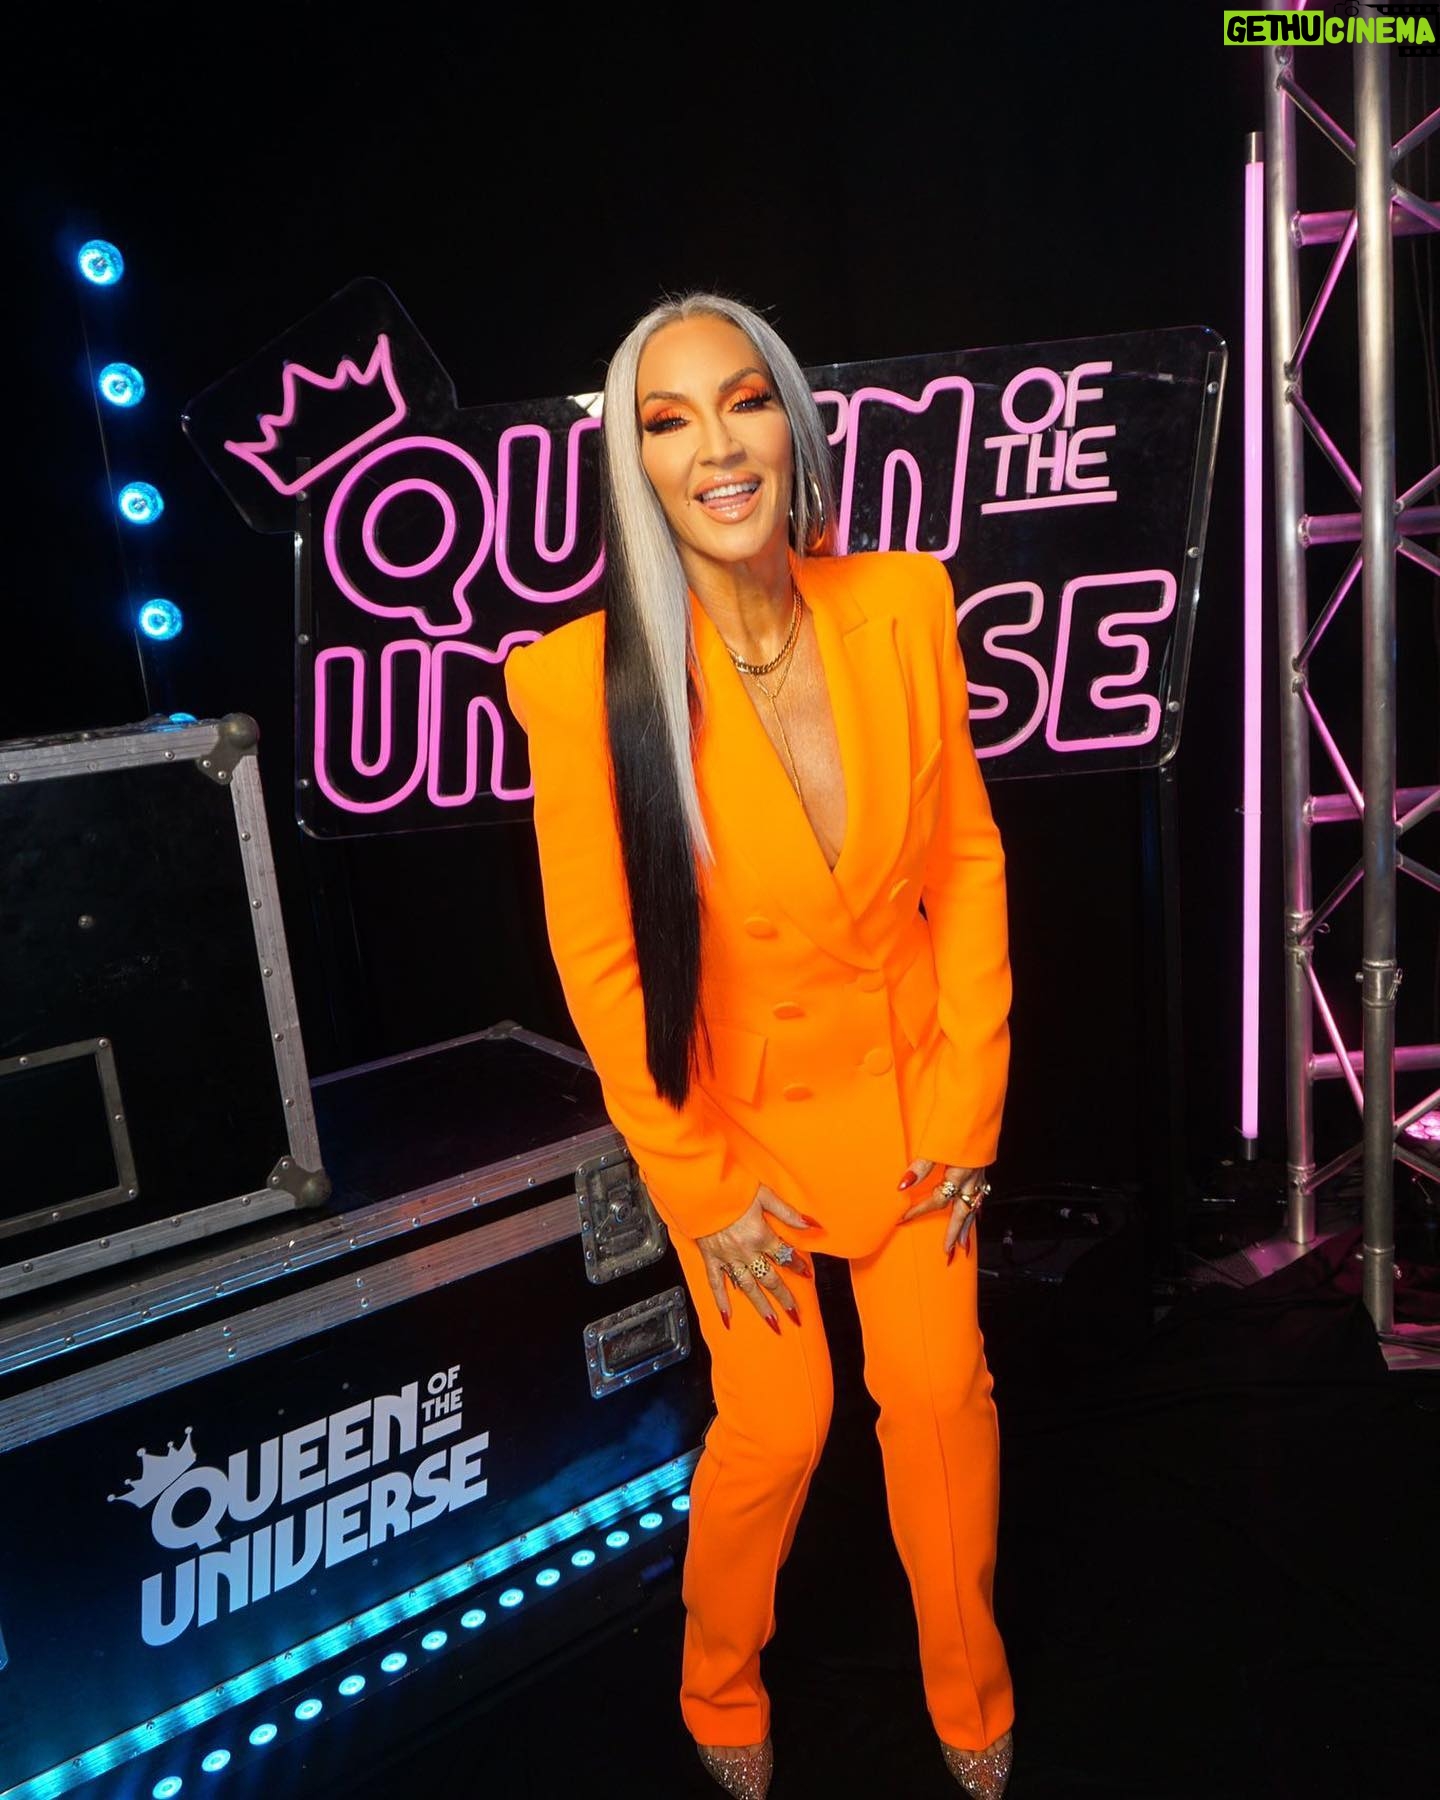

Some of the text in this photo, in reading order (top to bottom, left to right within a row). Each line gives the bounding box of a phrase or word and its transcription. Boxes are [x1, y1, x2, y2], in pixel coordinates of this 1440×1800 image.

[1001, 361, 1113, 434] OF
[984, 425, 1117, 497] THE
[324, 376, 975, 636] QUN
[421, 1387, 463, 1423] THE
[427, 1364, 461, 1395] OF
[151, 1381, 418, 1550] QUEEN
[141, 1431, 489, 1647] UNIVERSE
